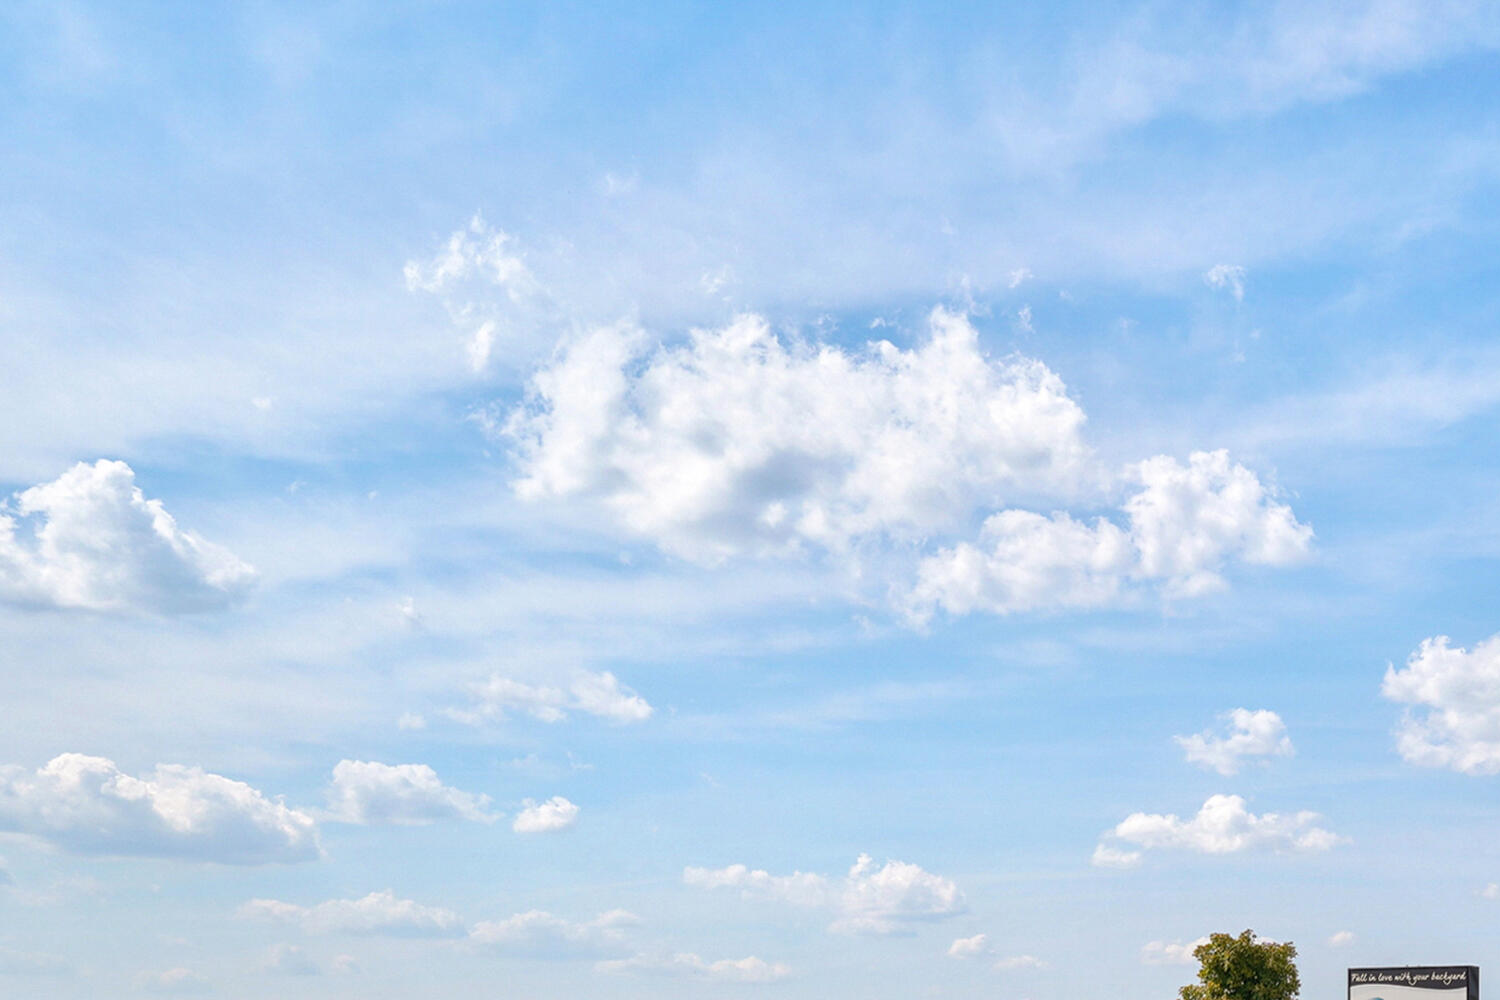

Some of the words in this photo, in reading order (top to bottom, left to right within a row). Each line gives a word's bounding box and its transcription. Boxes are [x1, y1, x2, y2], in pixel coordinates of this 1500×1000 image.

[1351, 973, 1367, 982] Fall
[1368, 973, 1376, 982] in
[1378, 972, 1393, 982] love
[1394, 971, 1411, 982] with
[1408, 973, 1430, 986] your
[1431, 971, 1467, 986] backyard
